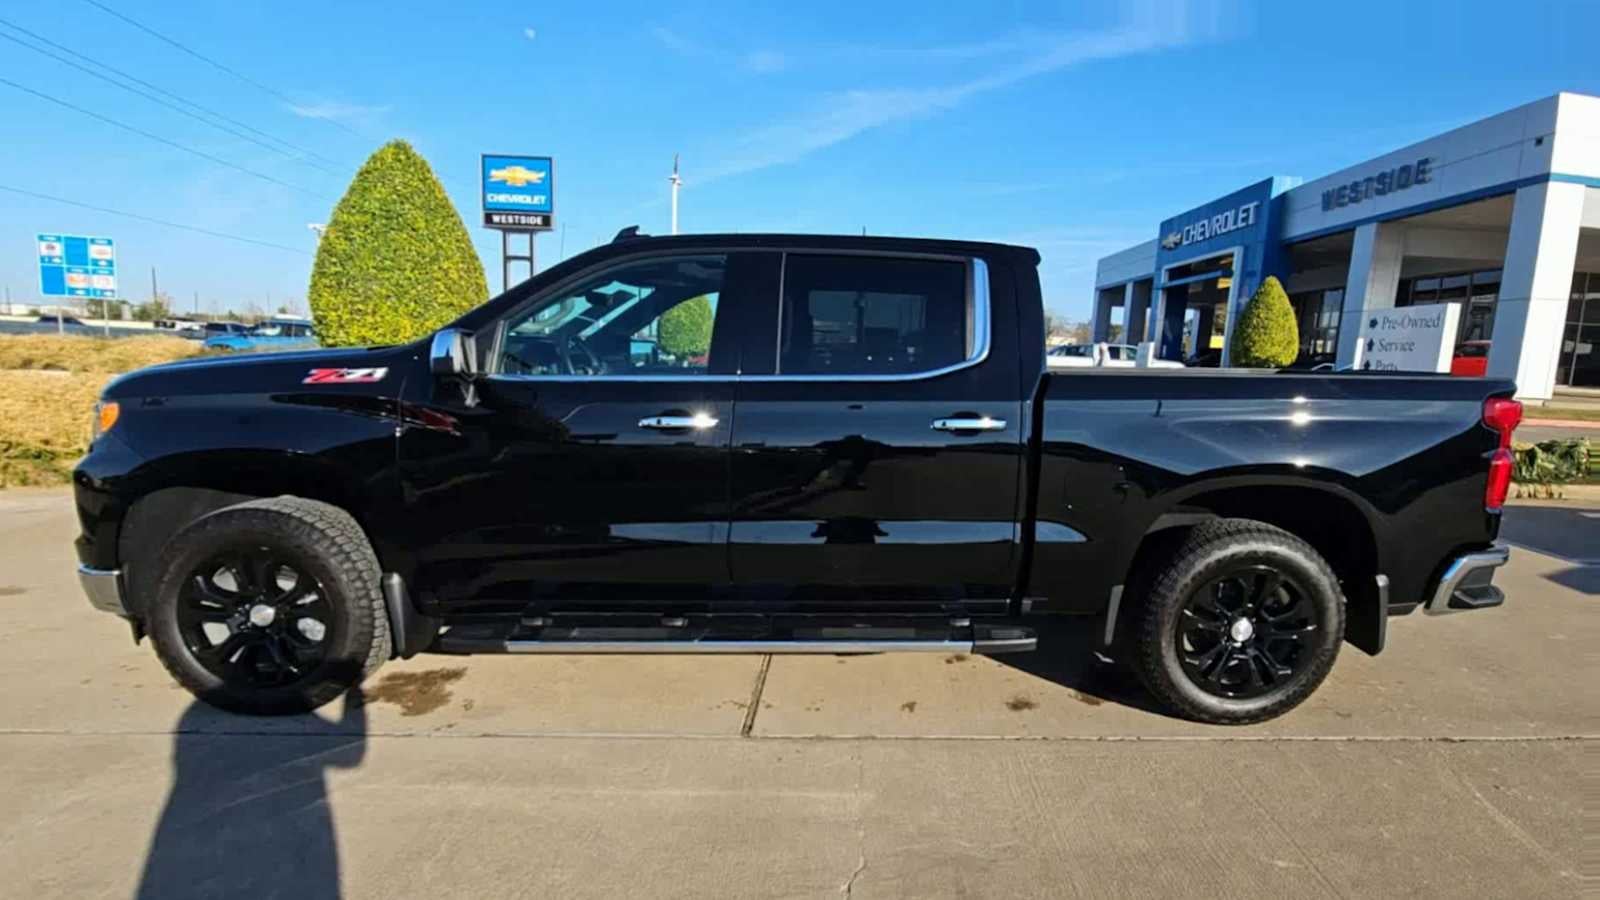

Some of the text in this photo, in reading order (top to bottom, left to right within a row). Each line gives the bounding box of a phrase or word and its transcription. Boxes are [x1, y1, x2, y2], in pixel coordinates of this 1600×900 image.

[1321, 157, 1433, 212] WESTSIDE
[486, 193, 546, 205] CHEVROLET
[491, 214, 543, 225] WESTSIDE
[1182, 201, 1260, 246] CHEVROLET
[1381, 312, 1442, 330] Pre-Owned
[1377, 339, 1416, 353] Service
[301, 366, 389, 384] Z71
